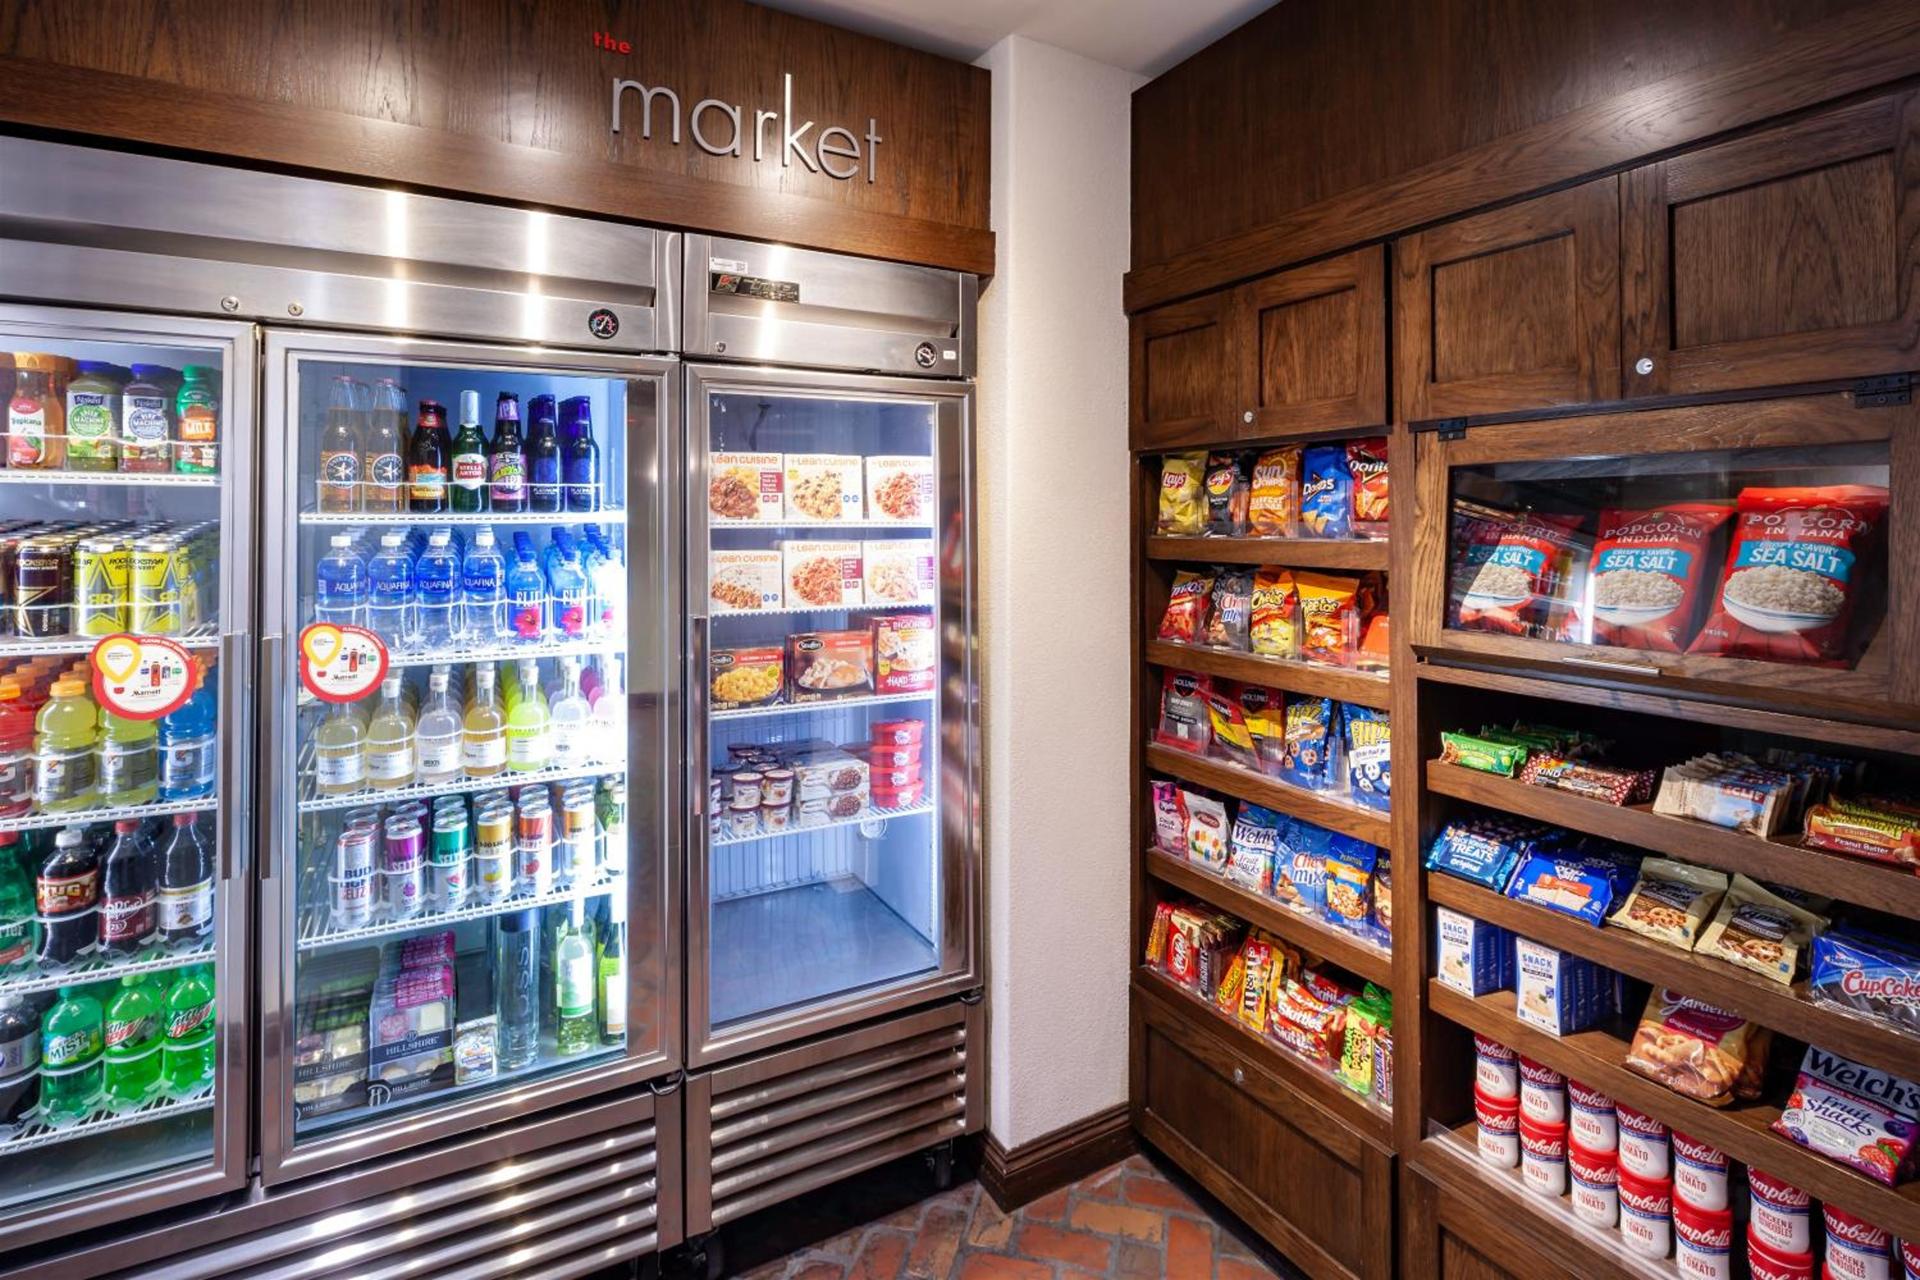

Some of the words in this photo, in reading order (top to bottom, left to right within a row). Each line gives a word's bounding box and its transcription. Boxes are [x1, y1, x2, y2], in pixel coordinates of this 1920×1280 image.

[593, 32, 633, 55] the
[611, 73, 883, 184] market
[738, 454, 778, 465] cuisine
[1604, 521, 1703, 539] POPCORN
[1616, 533, 1680, 543] INDIANA
[1501, 552, 1533, 566] SALT
[1800, 542, 1839, 555] SAVORY
[1605, 555, 1637, 568] SEA
[1638, 555, 1677, 570] SALT
[1749, 548, 1786, 564] SEA
[1791, 551, 1842, 573] SALT
[1537, 767, 1562, 778] KIND
[1235, 821, 1277, 846] Welch's
[1451, 842, 1495, 863] TREATS
[1835, 837, 1862, 849] Peanut
[1863, 843, 1889, 855] Butter
[344, 866, 372, 879] BUD
[1450, 858, 1481, 872] Original
[1442, 921, 1468, 936] SNACK
[1522, 953, 1553, 969] SNACK
[1842, 970, 1920, 998] CupCake
[1278, 999, 1322, 1032] Skittles
[50, 1034, 87, 1061] MIST
[1810, 1047, 1920, 1111] Welch's
[1804, 1098, 1877, 1137] Snacks
[1822, 1095, 1874, 1121] Fruit
[1573, 1115, 1602, 1136] TOMATO
[1621, 1140, 1649, 1161] TOMATO
[1679, 1169, 1707, 1193] TOMATO
[1577, 1190, 1606, 1211] TOMATO
[1625, 1218, 1654, 1241] TOMATO
[1683, 1252, 1716, 1277] TOMATO
